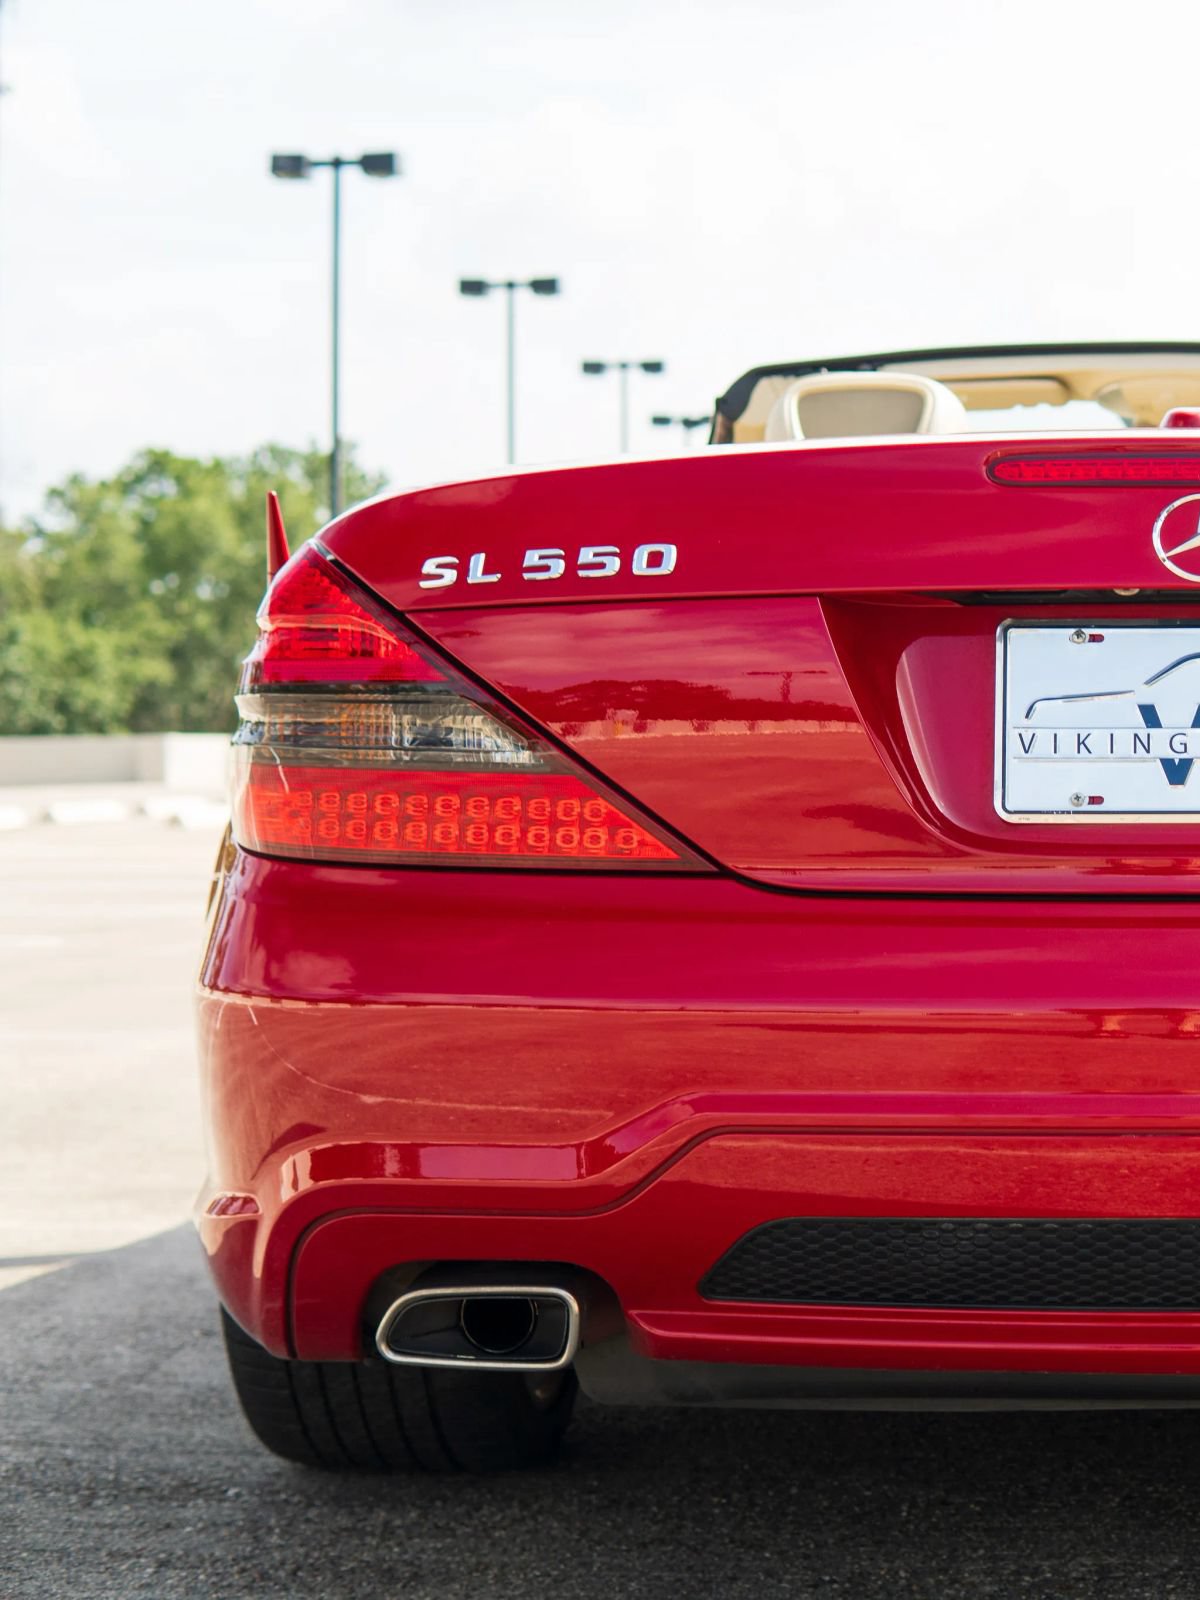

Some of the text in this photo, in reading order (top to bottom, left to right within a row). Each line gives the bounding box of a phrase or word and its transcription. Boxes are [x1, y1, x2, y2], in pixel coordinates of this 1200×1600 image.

[418, 543, 678, 589] SL 550
[1018, 732, 1189, 755] VIKING
